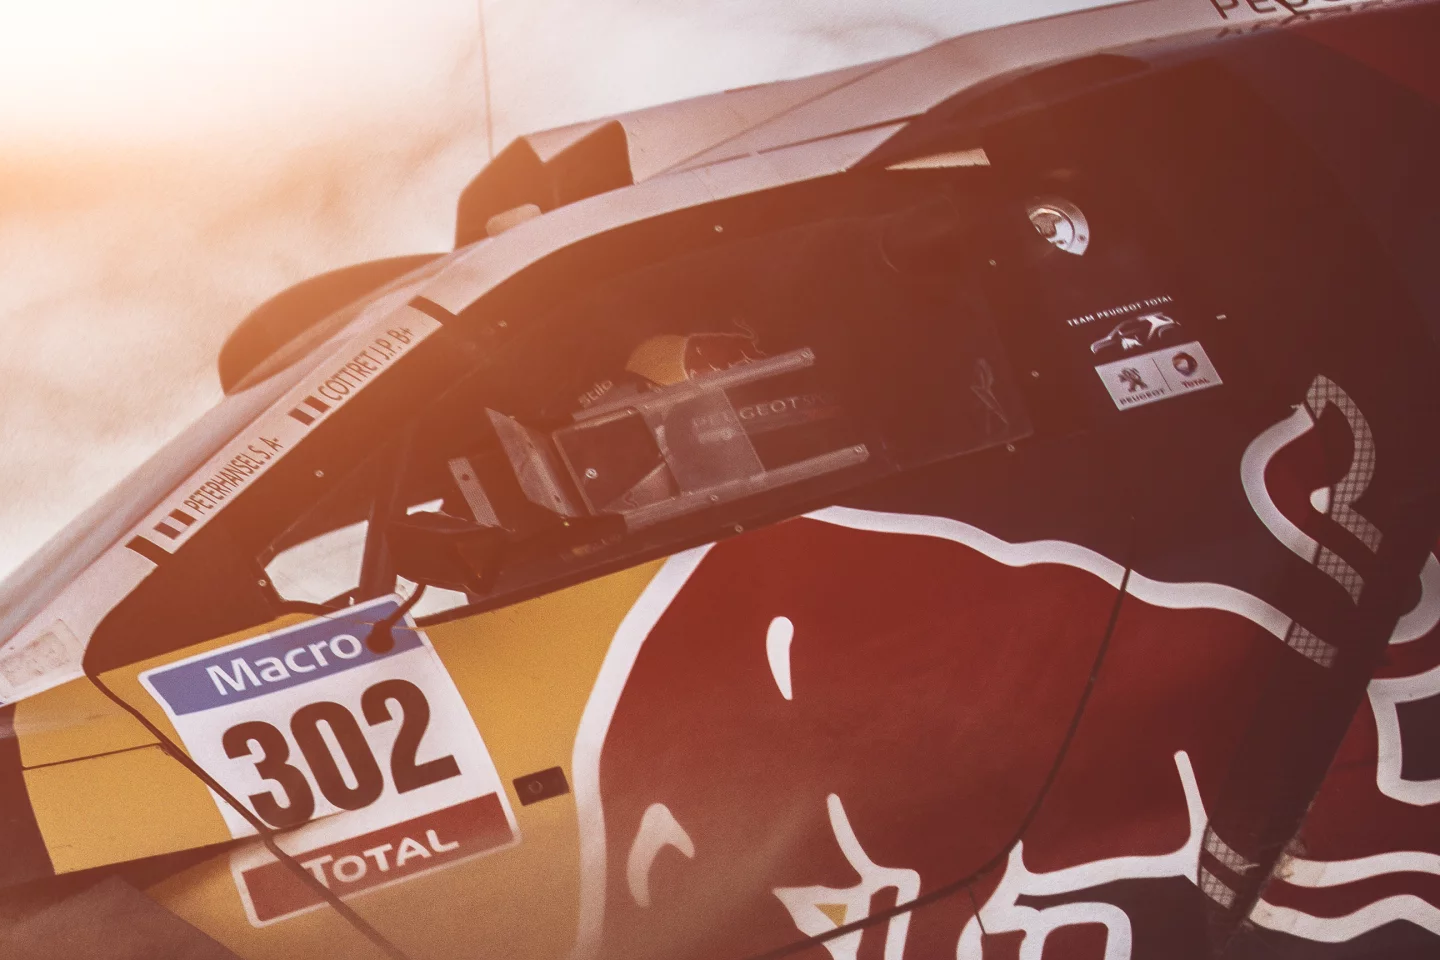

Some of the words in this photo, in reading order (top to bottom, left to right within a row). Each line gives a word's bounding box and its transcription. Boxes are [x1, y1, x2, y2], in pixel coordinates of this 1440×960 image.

[1066, 315, 1095, 327] TEAM
[1097, 302, 1142, 319] PEUGEOT
[1144, 295, 1173, 308] TOTAL
[317, 350, 383, 401] COTTRET
[1120, 388, 1166, 405] PEUGEOT
[1180, 377, 1210, 389] TOTAL
[183, 452, 265, 515] PETERHANSEL
[204, 632, 363, 696] Macro
[221, 678, 462, 829] 302
[302, 828, 460, 888] TOTAL
